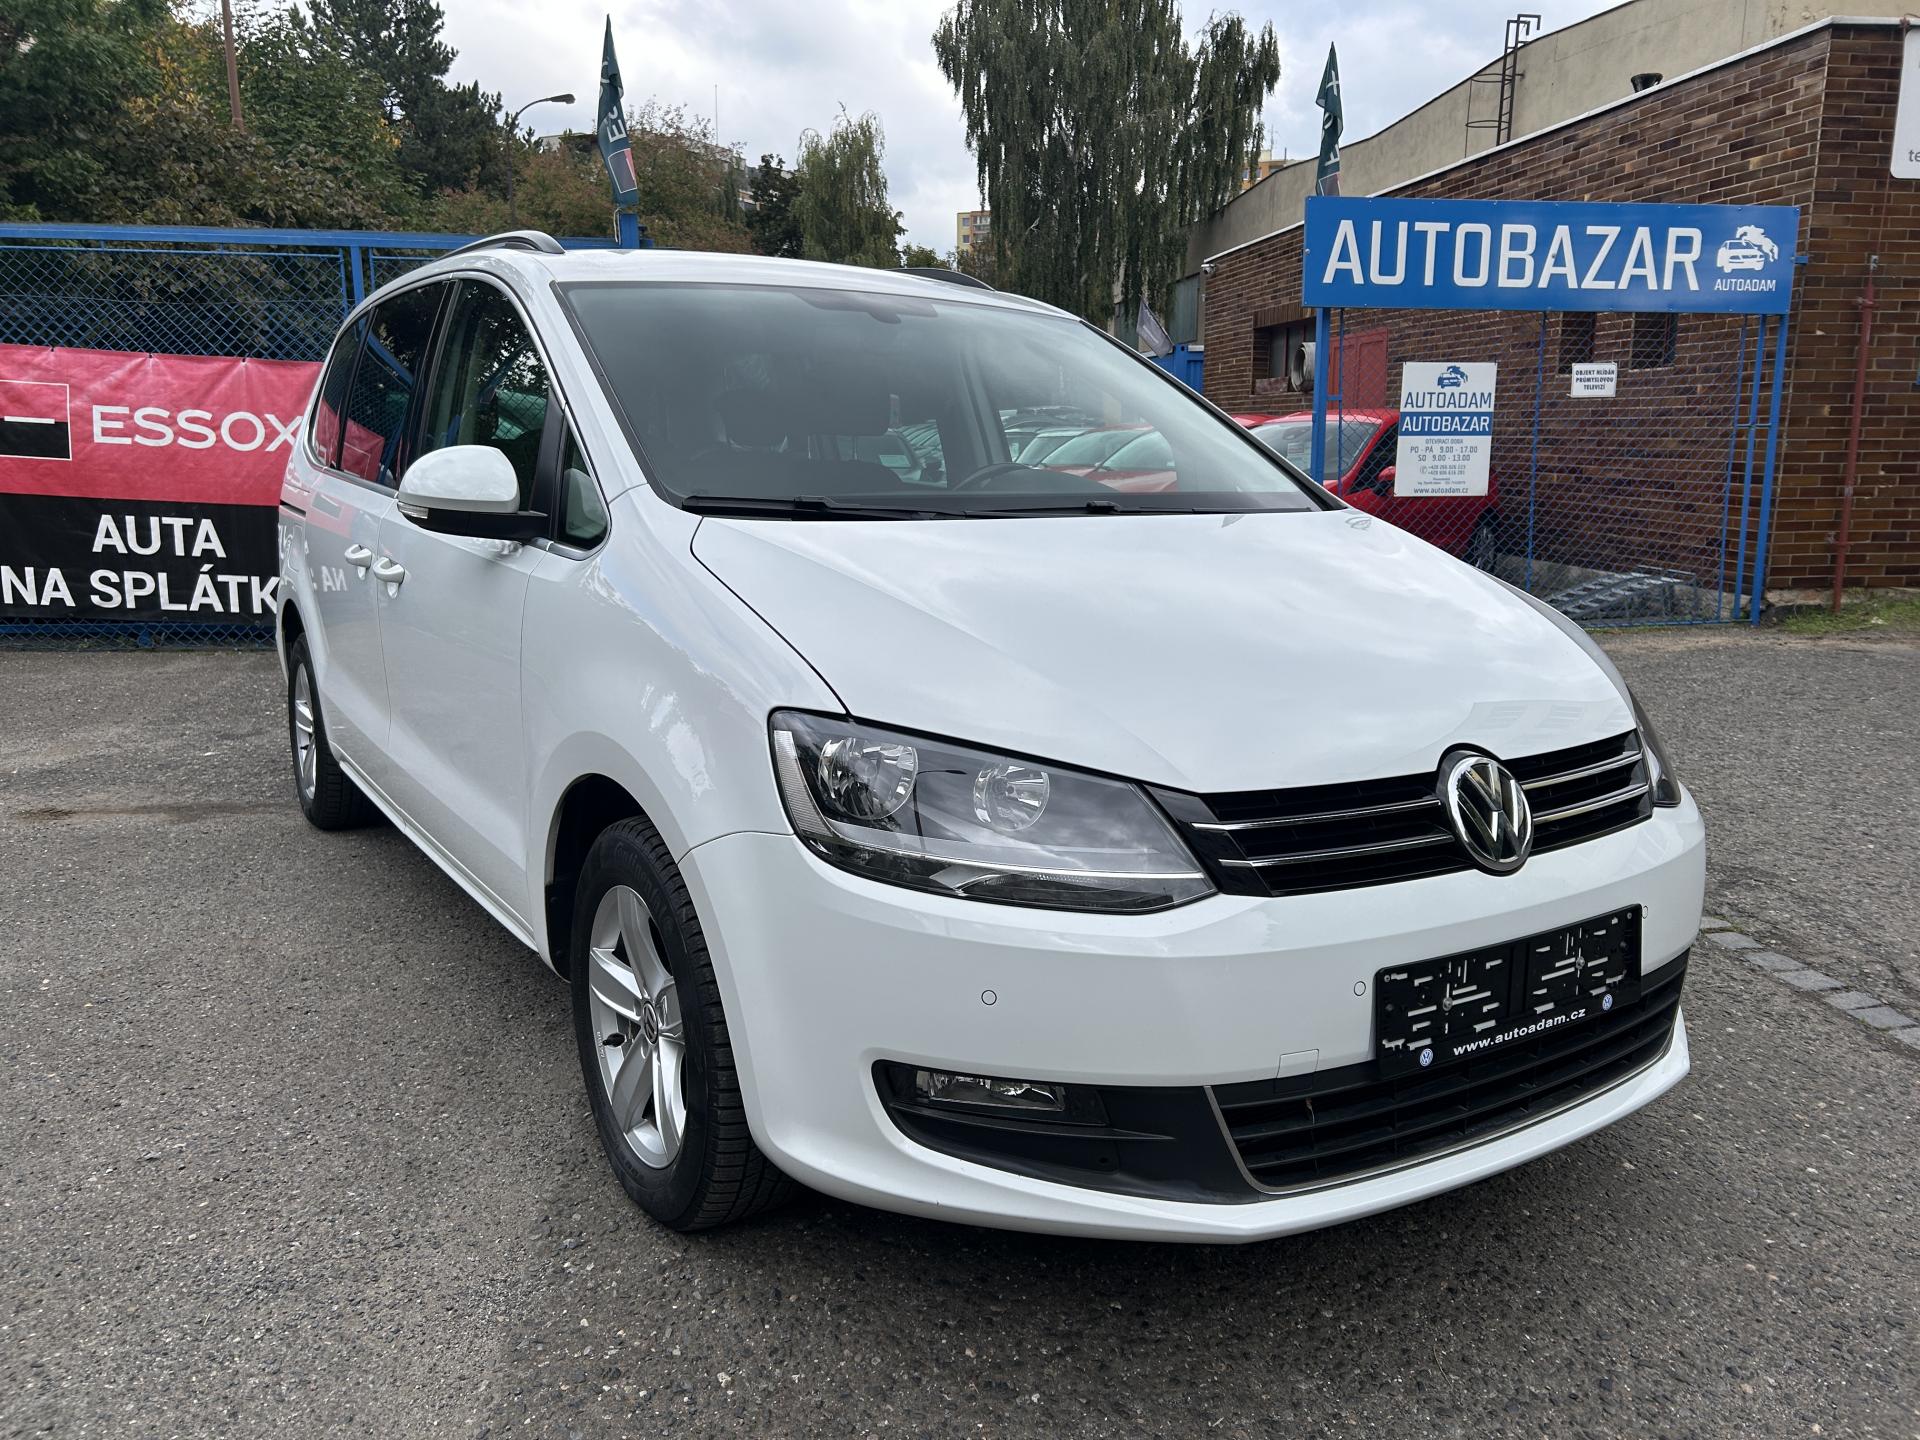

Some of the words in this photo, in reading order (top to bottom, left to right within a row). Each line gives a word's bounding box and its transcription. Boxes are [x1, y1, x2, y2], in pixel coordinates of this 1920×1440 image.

[1322, 219, 1703, 291] AUTOBAZAR
[1714, 278, 1776, 292] AUTOADAM
[1404, 391, 1492, 408] AUTOADAM
[92, 404, 304, 452] ESSOX
[1402, 415, 1490, 432] AUTOBAZAR
[1418, 454, 1427, 462] SO
[1432, 454, 1446, 462] 9.00
[1452, 454, 1471, 462] 13.00
[1425, 444, 1434, 453] PÁ
[92, 514, 226, 558] AUTA
[0, 565, 76, 607] NA
[89, 564, 280, 615] SPLÁTK
[1453, 1008, 1586, 1056] www.autoadam.cz
